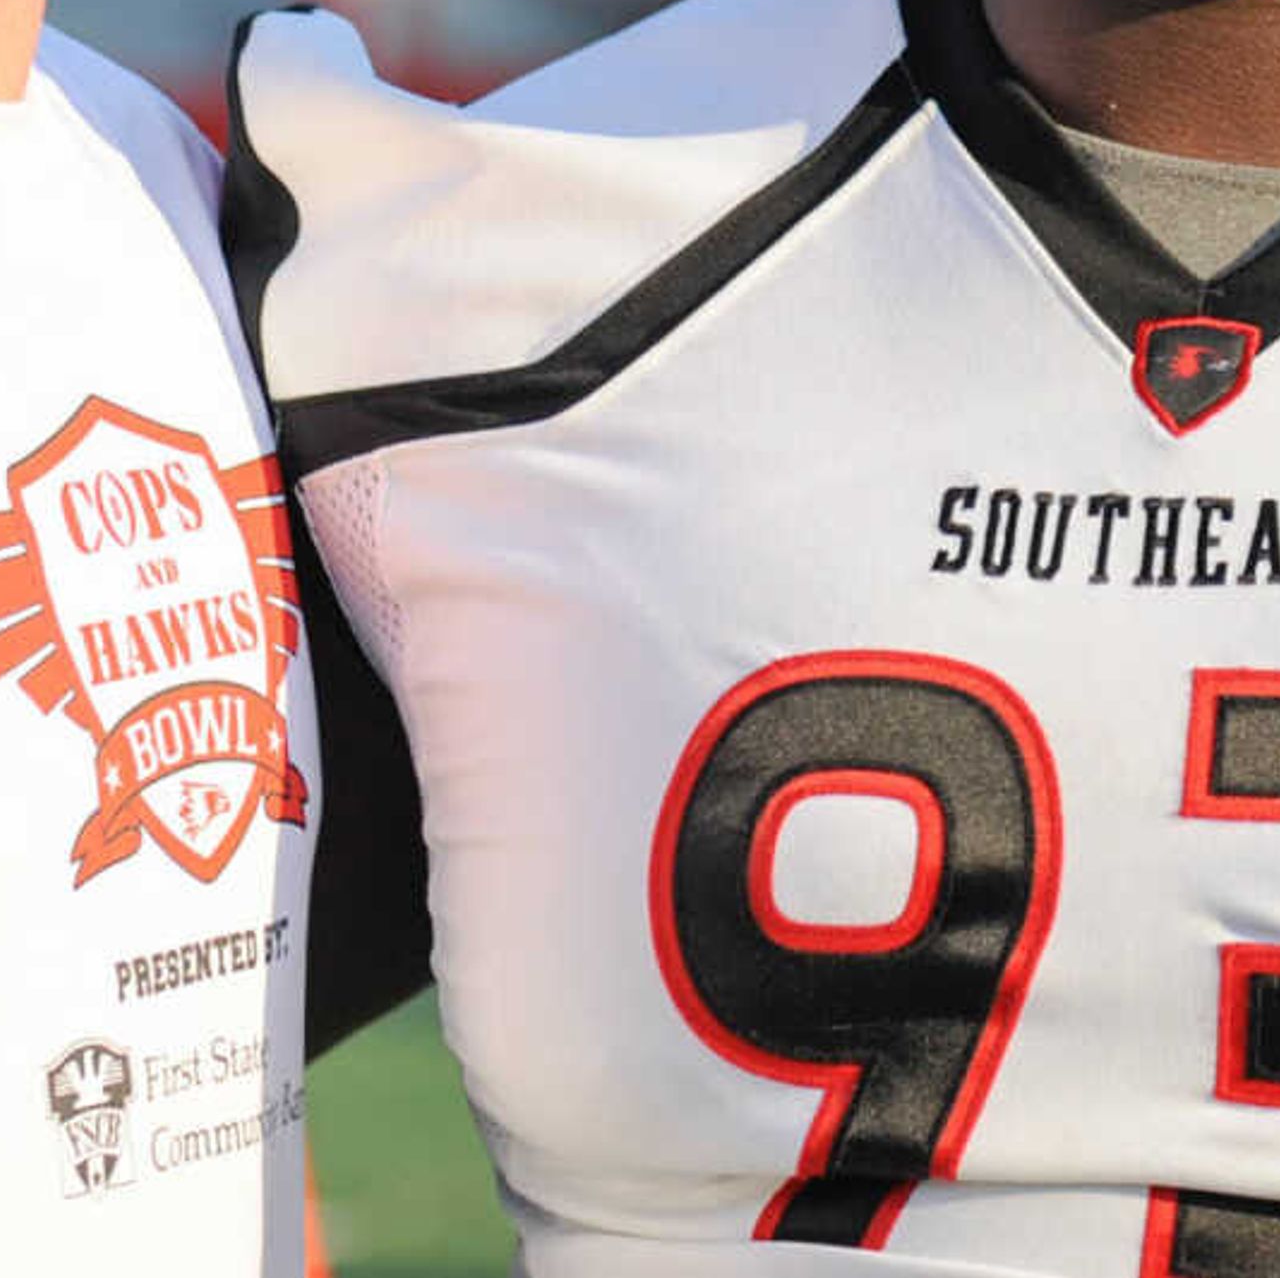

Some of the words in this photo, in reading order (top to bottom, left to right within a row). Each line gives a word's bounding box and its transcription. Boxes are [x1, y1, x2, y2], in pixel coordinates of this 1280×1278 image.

[62, 461, 204, 554] COPS
[136, 558, 180, 589] AND
[80, 590, 258, 685] HAWKS
[125, 696, 258, 780] BOWL
[114, 929, 257, 1002] PRESENTED
[144, 1045, 202, 1102] First
